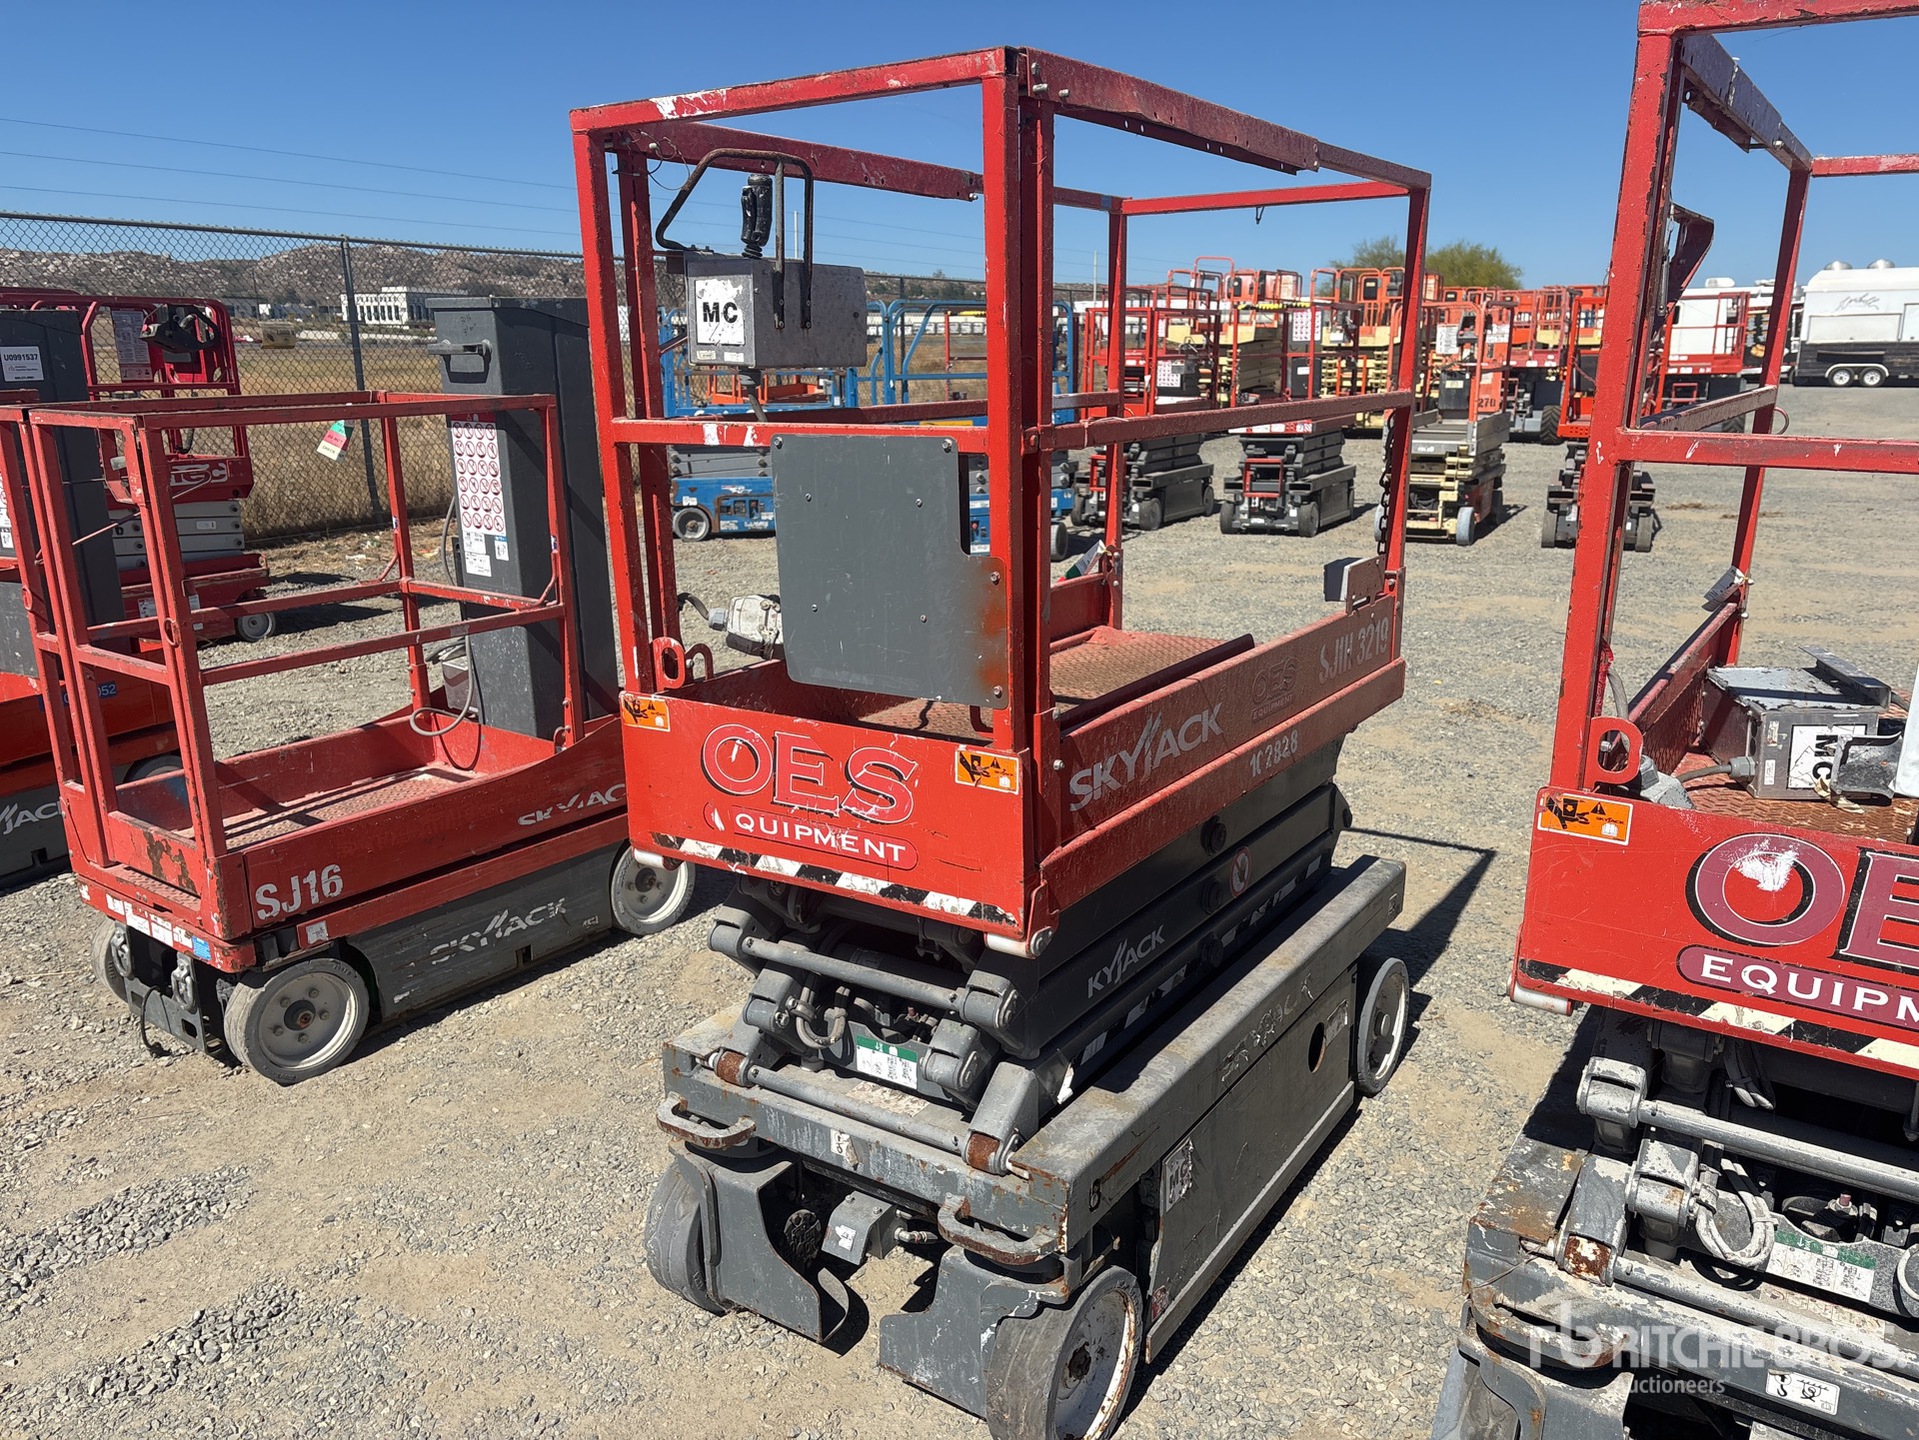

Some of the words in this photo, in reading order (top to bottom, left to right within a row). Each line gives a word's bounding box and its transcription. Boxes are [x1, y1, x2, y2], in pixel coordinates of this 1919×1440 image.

[702, 302, 738, 324] MC
[3, 353, 38, 361] U0991537
[1357, 617, 1389, 665] 3219
[701, 723, 919, 824] OES
[1069, 702, 1224, 812] SKYJACK
[255, 864, 344, 920] SJ16
